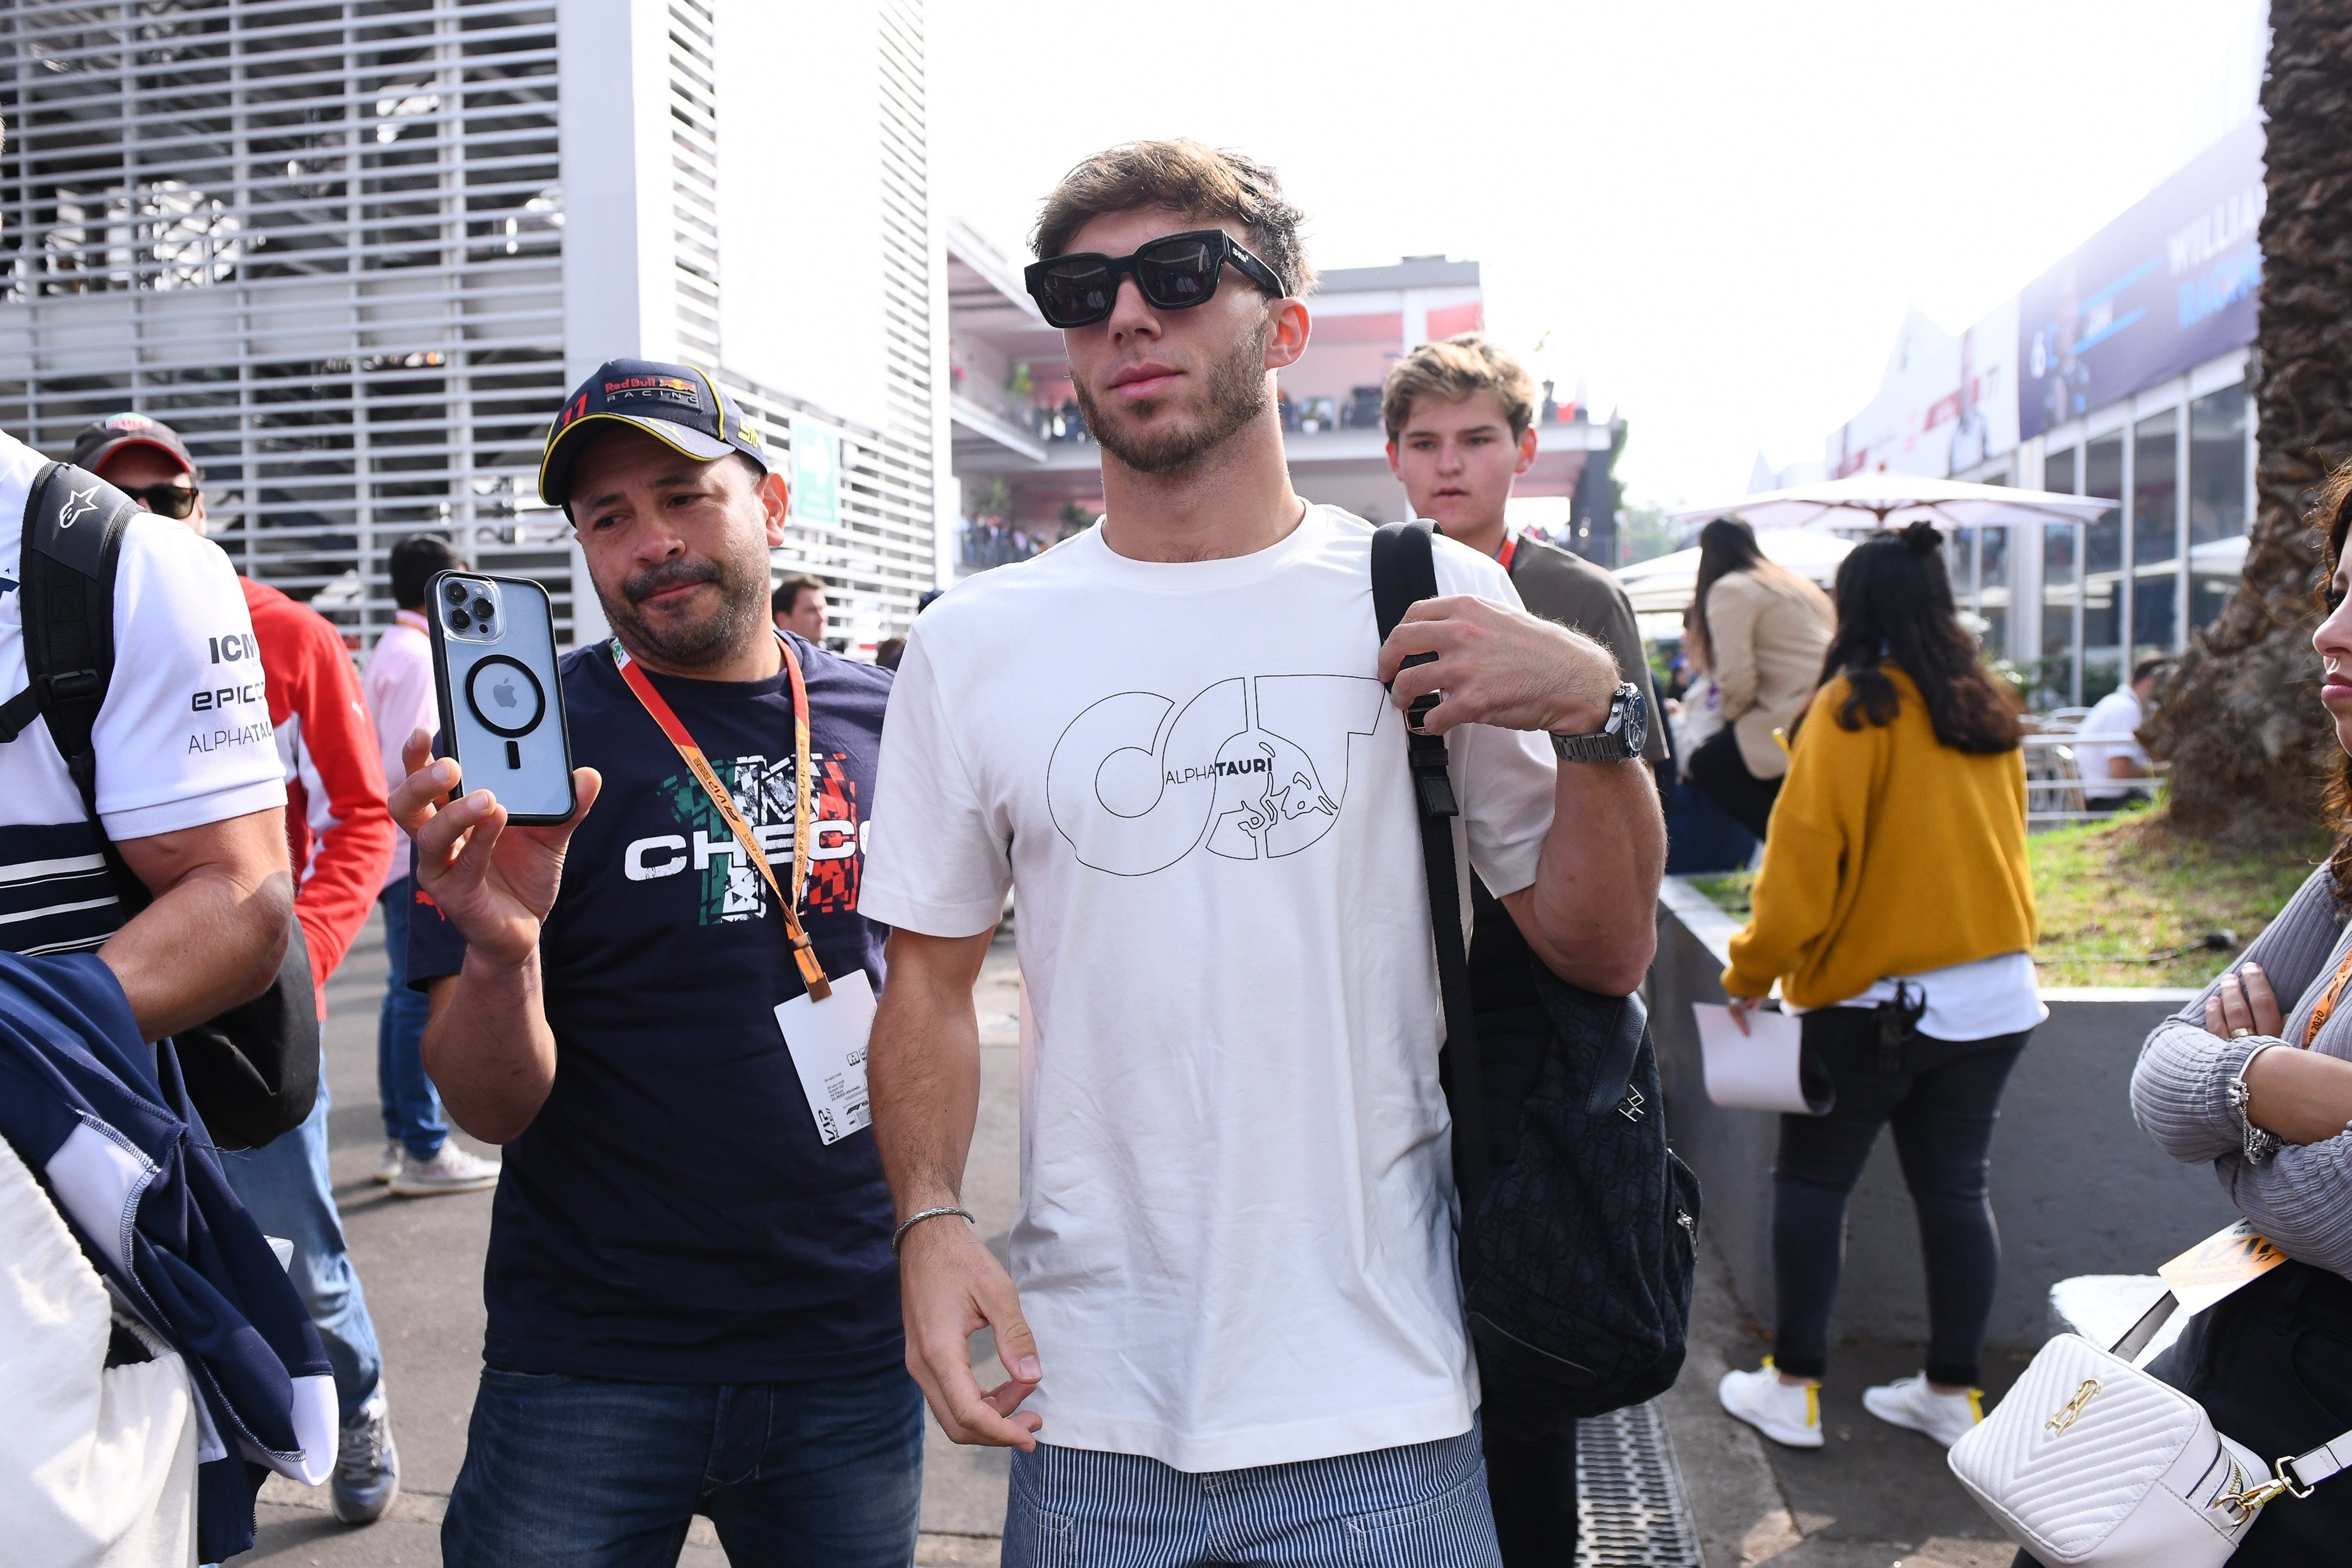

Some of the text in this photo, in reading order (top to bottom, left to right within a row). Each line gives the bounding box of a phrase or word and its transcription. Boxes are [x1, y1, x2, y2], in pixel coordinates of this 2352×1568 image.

[2167, 182, 2268, 276] WILLIA
[2179, 242, 2266, 329] RACIN
[604, 377, 656, 393] Red Bull
[607, 390, 699, 404] RACING
[188, 721, 272, 755] ALPHATAU
[1165, 757, 1272, 785] ALPHATAURI
[624, 820, 871, 881] CHEC
[818, 1109, 836, 1142] VIP
